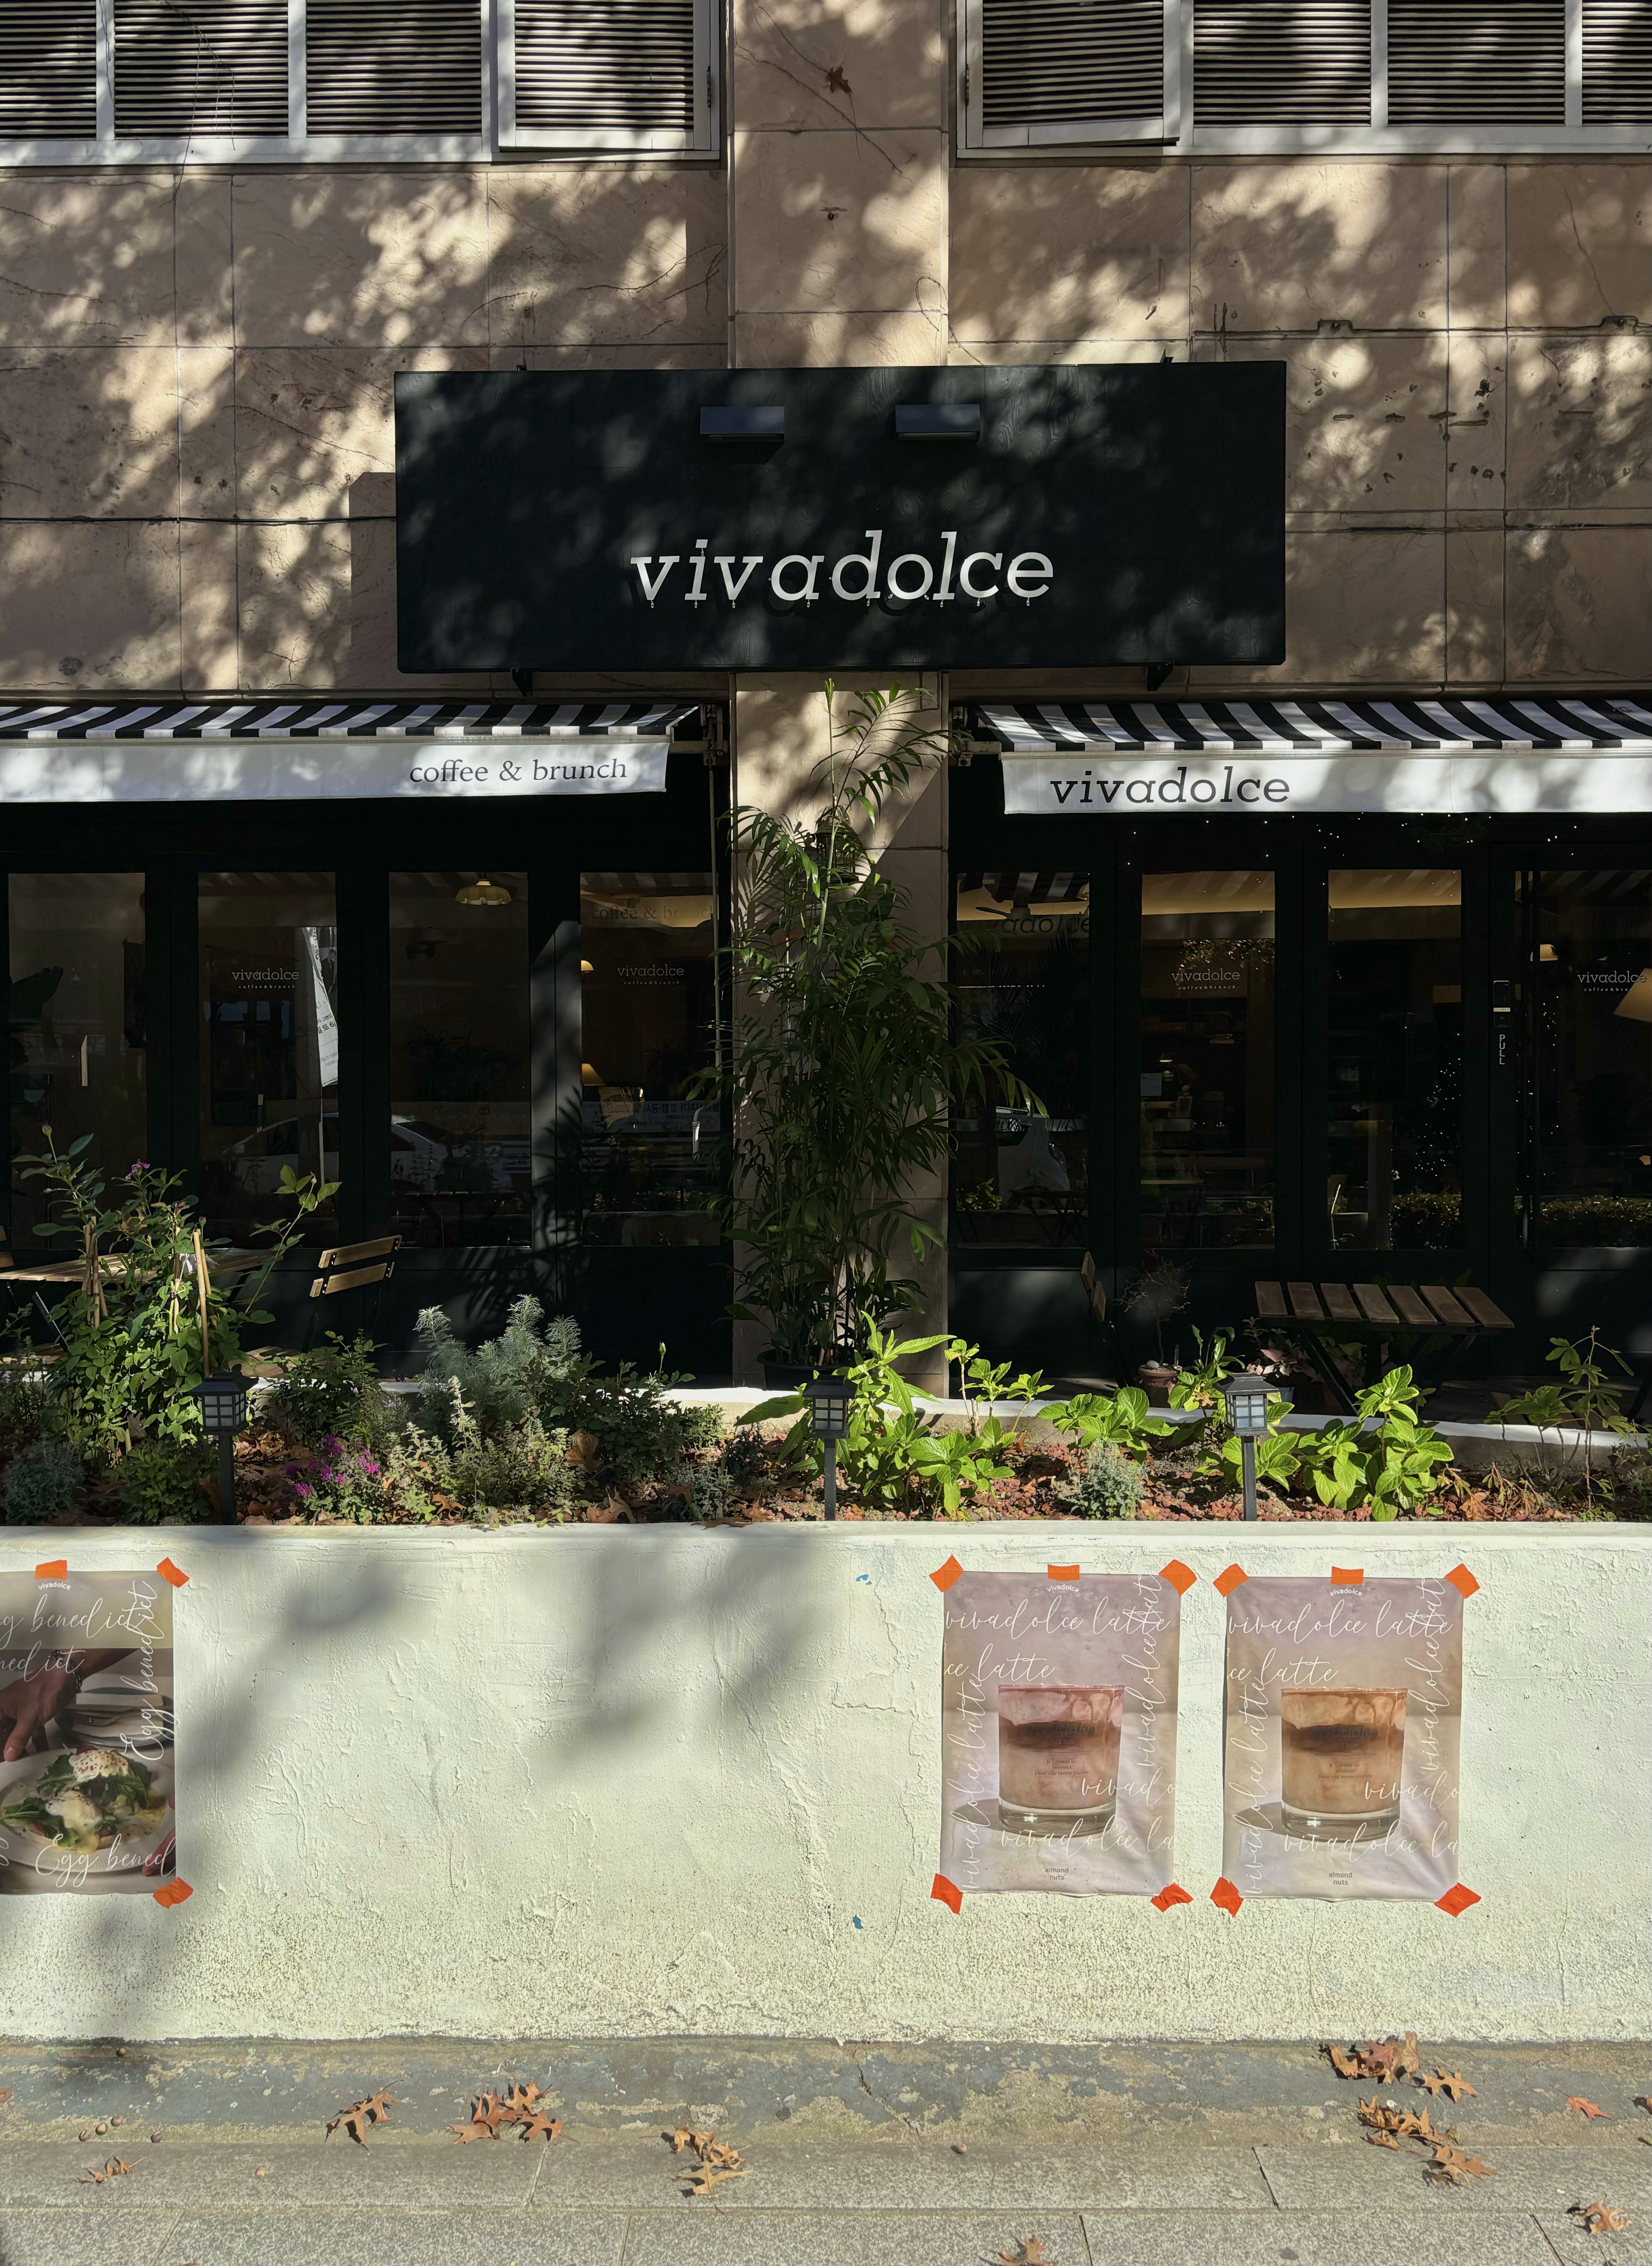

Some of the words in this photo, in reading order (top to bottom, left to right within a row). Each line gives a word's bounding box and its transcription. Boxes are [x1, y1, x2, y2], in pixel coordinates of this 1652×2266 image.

[631, 530, 1053, 601] vivadolce
[410, 759, 488, 782] coffee
[499, 761, 522, 781] &
[533, 758, 627, 781] brunch
[1050, 766, 1290, 803] vivadolce
[592, 905, 637, 920] coffee
[644, 906, 656, 919] &
[232, 968, 299, 981] vivadolce
[617, 964, 684, 976] vivadolce
[1171, 969, 1240, 981] vivadolce
[1577, 971, 1647, 983] vivadolce
[38, 1581, 71, 1590] vivadolce
[1047, 1583, 1079, 1593] vivadolce
[1330, 1587, 1362, 1597] vivadolce
[31, 1593, 147, 1638] benedict
[946, 1595, 1084, 1640] vivadolce
[1093, 1596, 1171, 1634] latte
[1228, 1599, 1366, 1644] vivadolce
[1376, 1600, 1453, 1638] latte
[120, 1580, 165, 1692] benedict
[978, 1643, 1055, 1681] latte
[1261, 1648, 1338, 1685] latte
[947, 1673, 986, 1748] latte
[1230, 1677, 1268, 1752] latte
[946, 1757, 990, 1888] vivadolce
[1229, 1760, 1273, 1893] vivadolce
[36, 1833, 99, 1887] Egg
